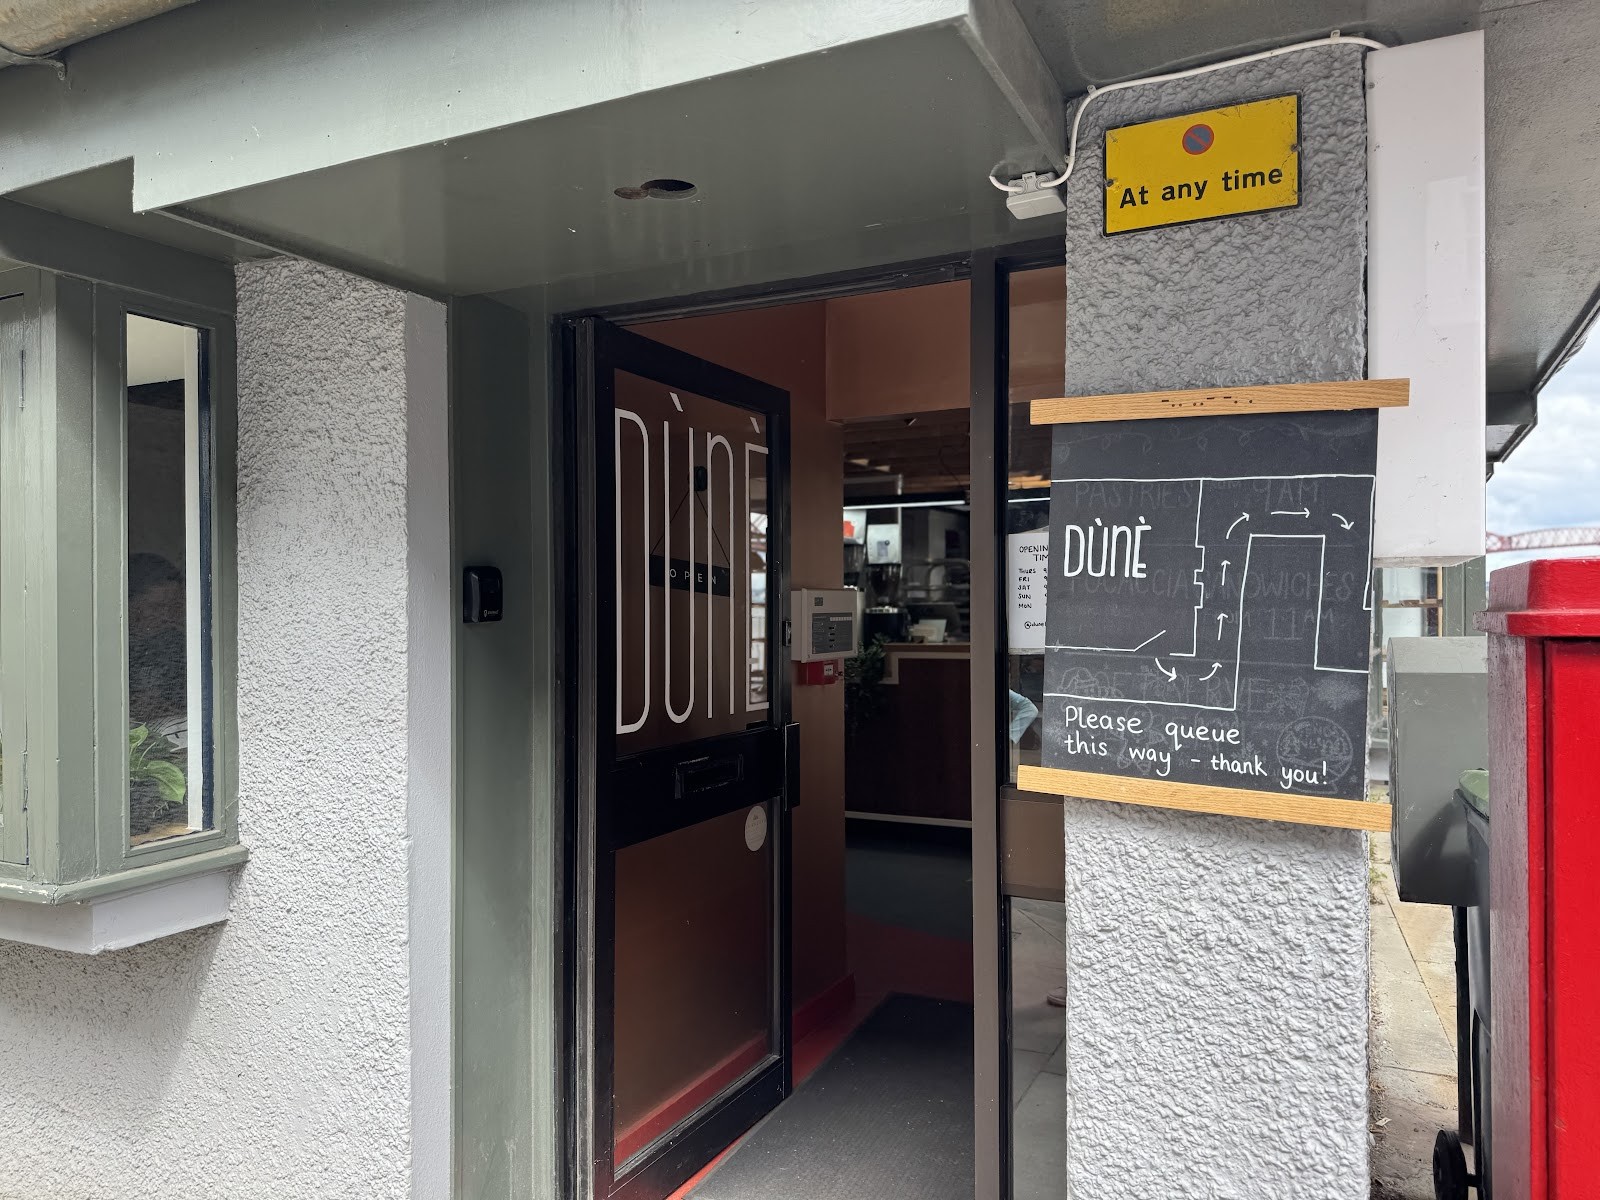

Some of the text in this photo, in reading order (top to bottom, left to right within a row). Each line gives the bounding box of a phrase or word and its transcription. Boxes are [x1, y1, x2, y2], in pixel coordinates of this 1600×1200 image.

[1119, 168, 1283, 209] At any time
[1064, 705, 1144, 734] Please
[1165, 721, 1241, 751] queue
[1064, 733, 1108, 757] this
[1129, 746, 1172, 777] way
[1211, 754, 1268, 777] thank
[1279, 761, 1328, 790] you!
